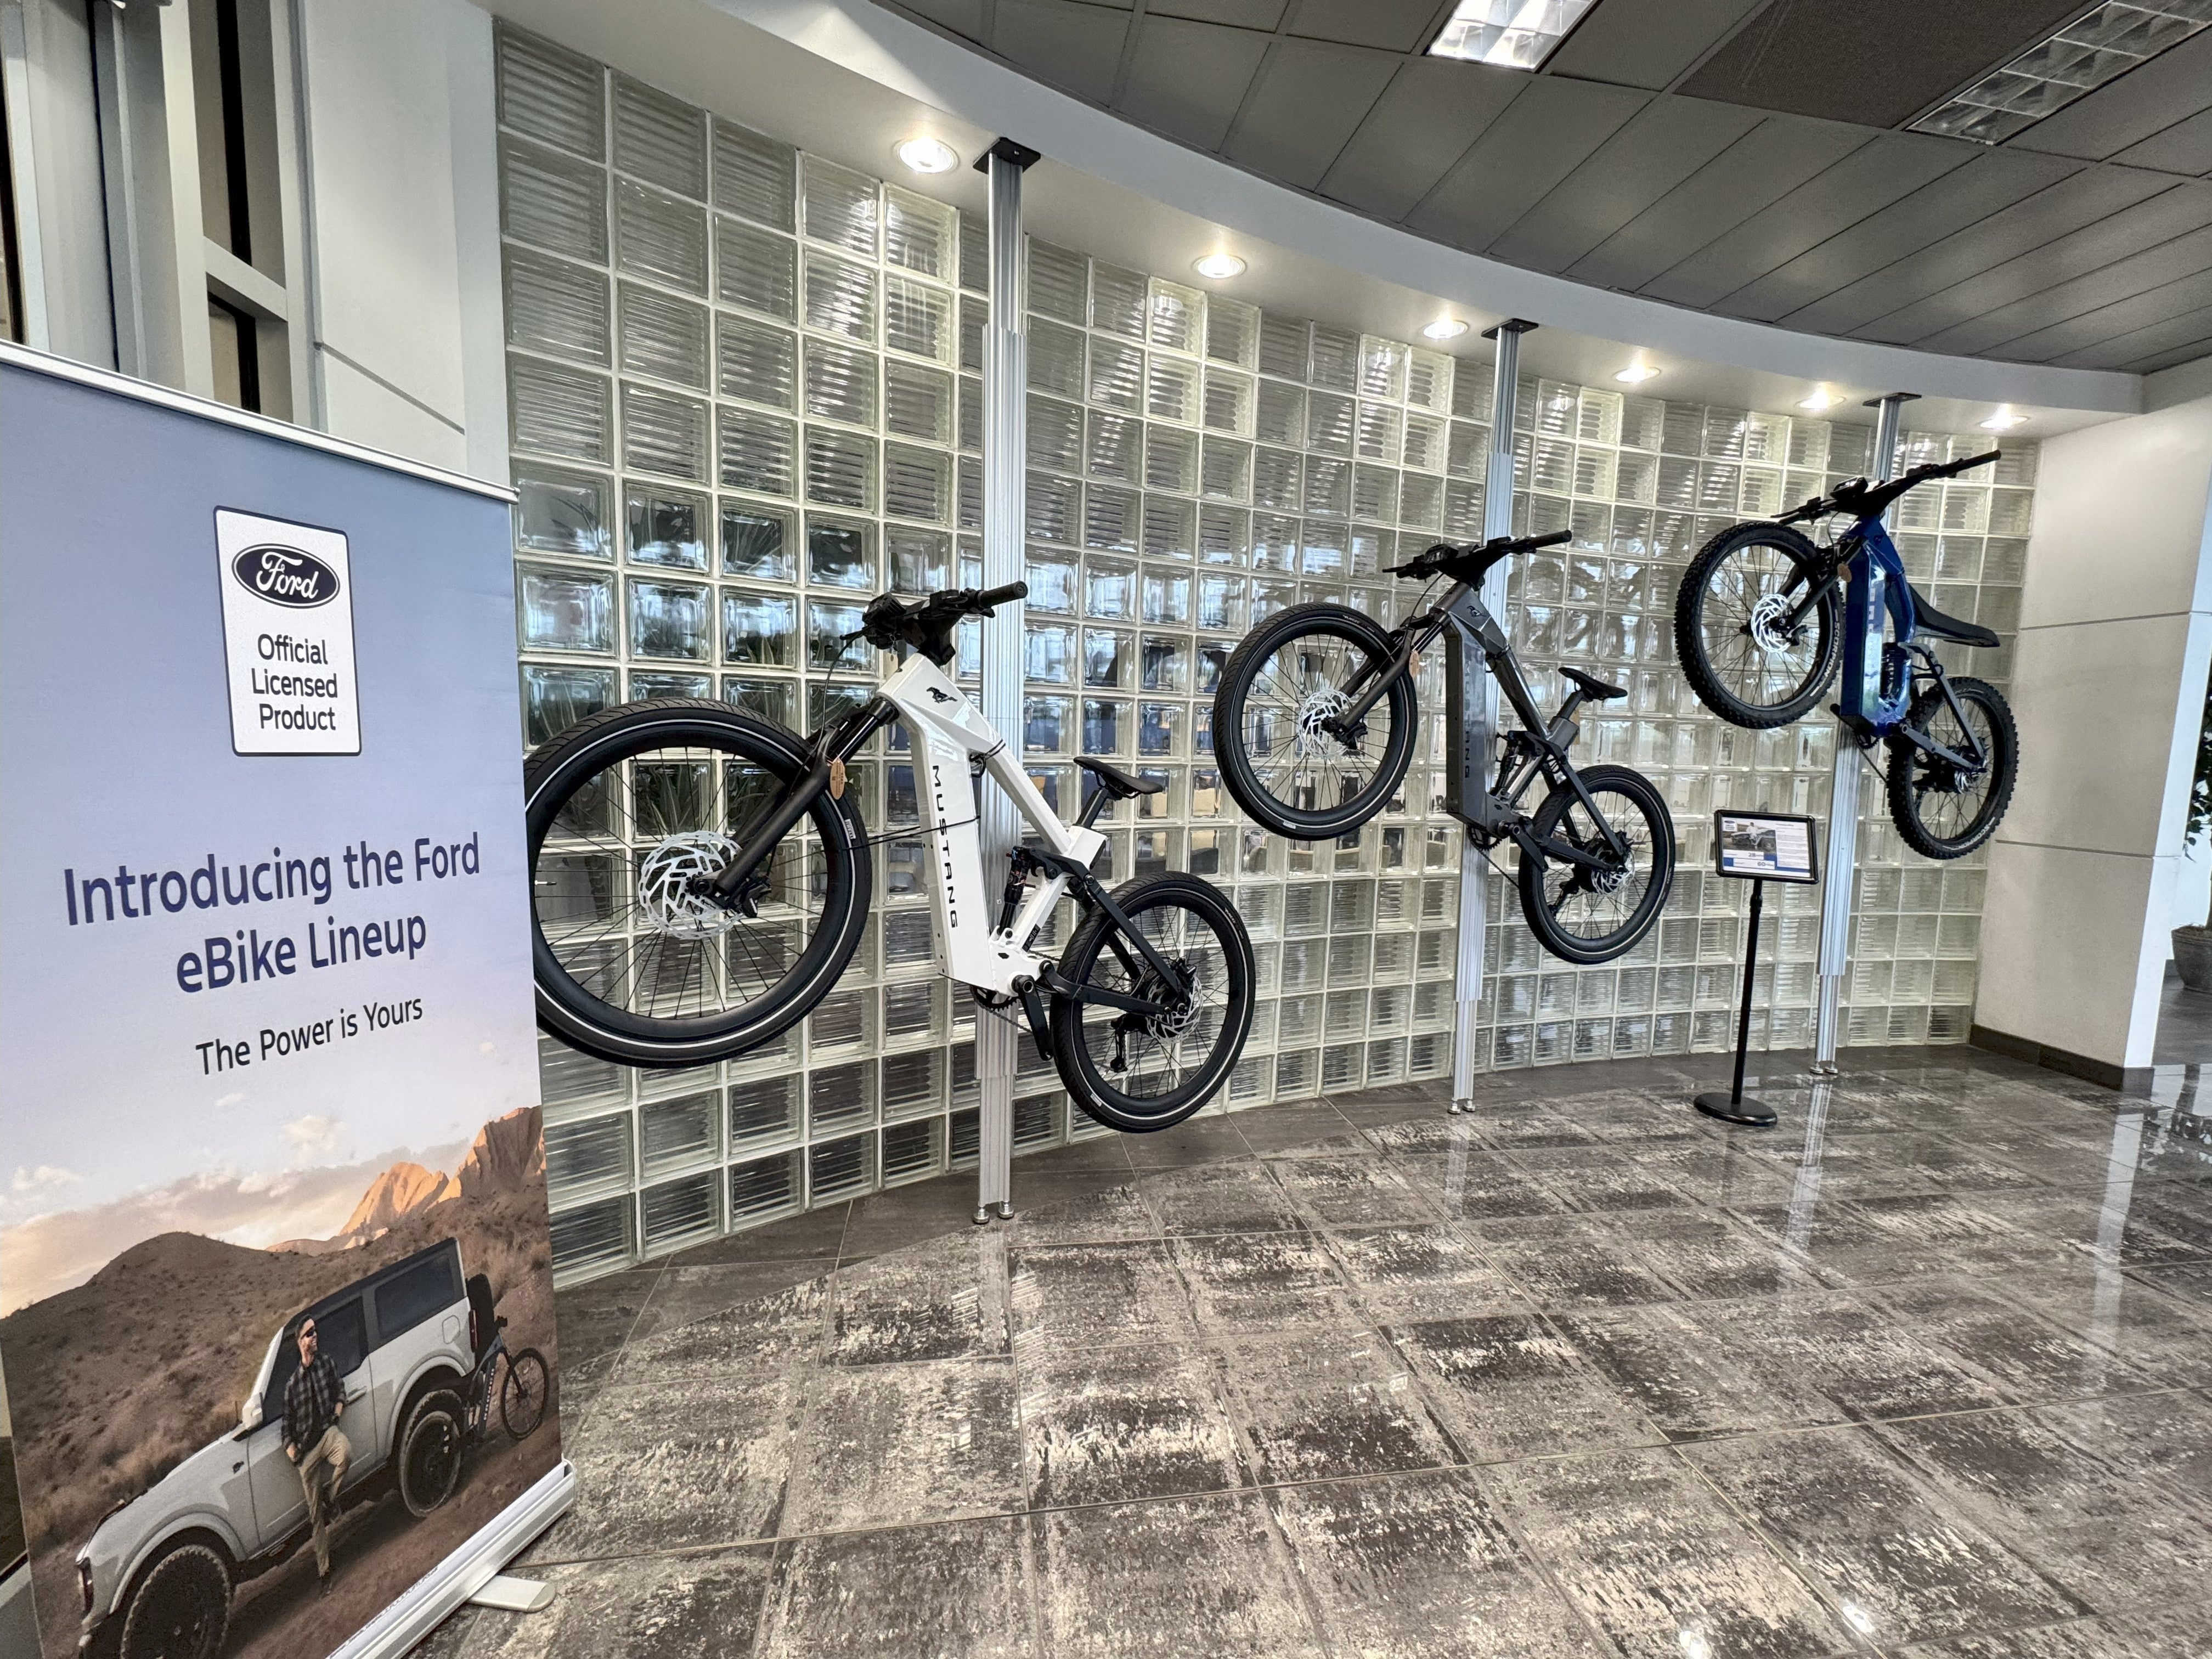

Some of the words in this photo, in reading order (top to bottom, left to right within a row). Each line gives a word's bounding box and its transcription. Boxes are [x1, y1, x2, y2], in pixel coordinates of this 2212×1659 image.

[256, 551, 319, 599] Ford
[258, 634, 328, 665] Official
[251, 668, 338, 698] Licensed
[259, 703, 336, 731] Product
[933, 765, 958, 928] MUSTANG
[64, 847, 332, 926] Introducing
[343, 840, 403, 889] the
[414, 831, 480, 882] Ford
[177, 929, 296, 993] eBike
[308, 915, 427, 969] Lineup
[195, 1038, 251, 1075] The
[259, 1018, 334, 1061] Power
[340, 1008, 358, 1039] is
[363, 998, 422, 1031] Yours
